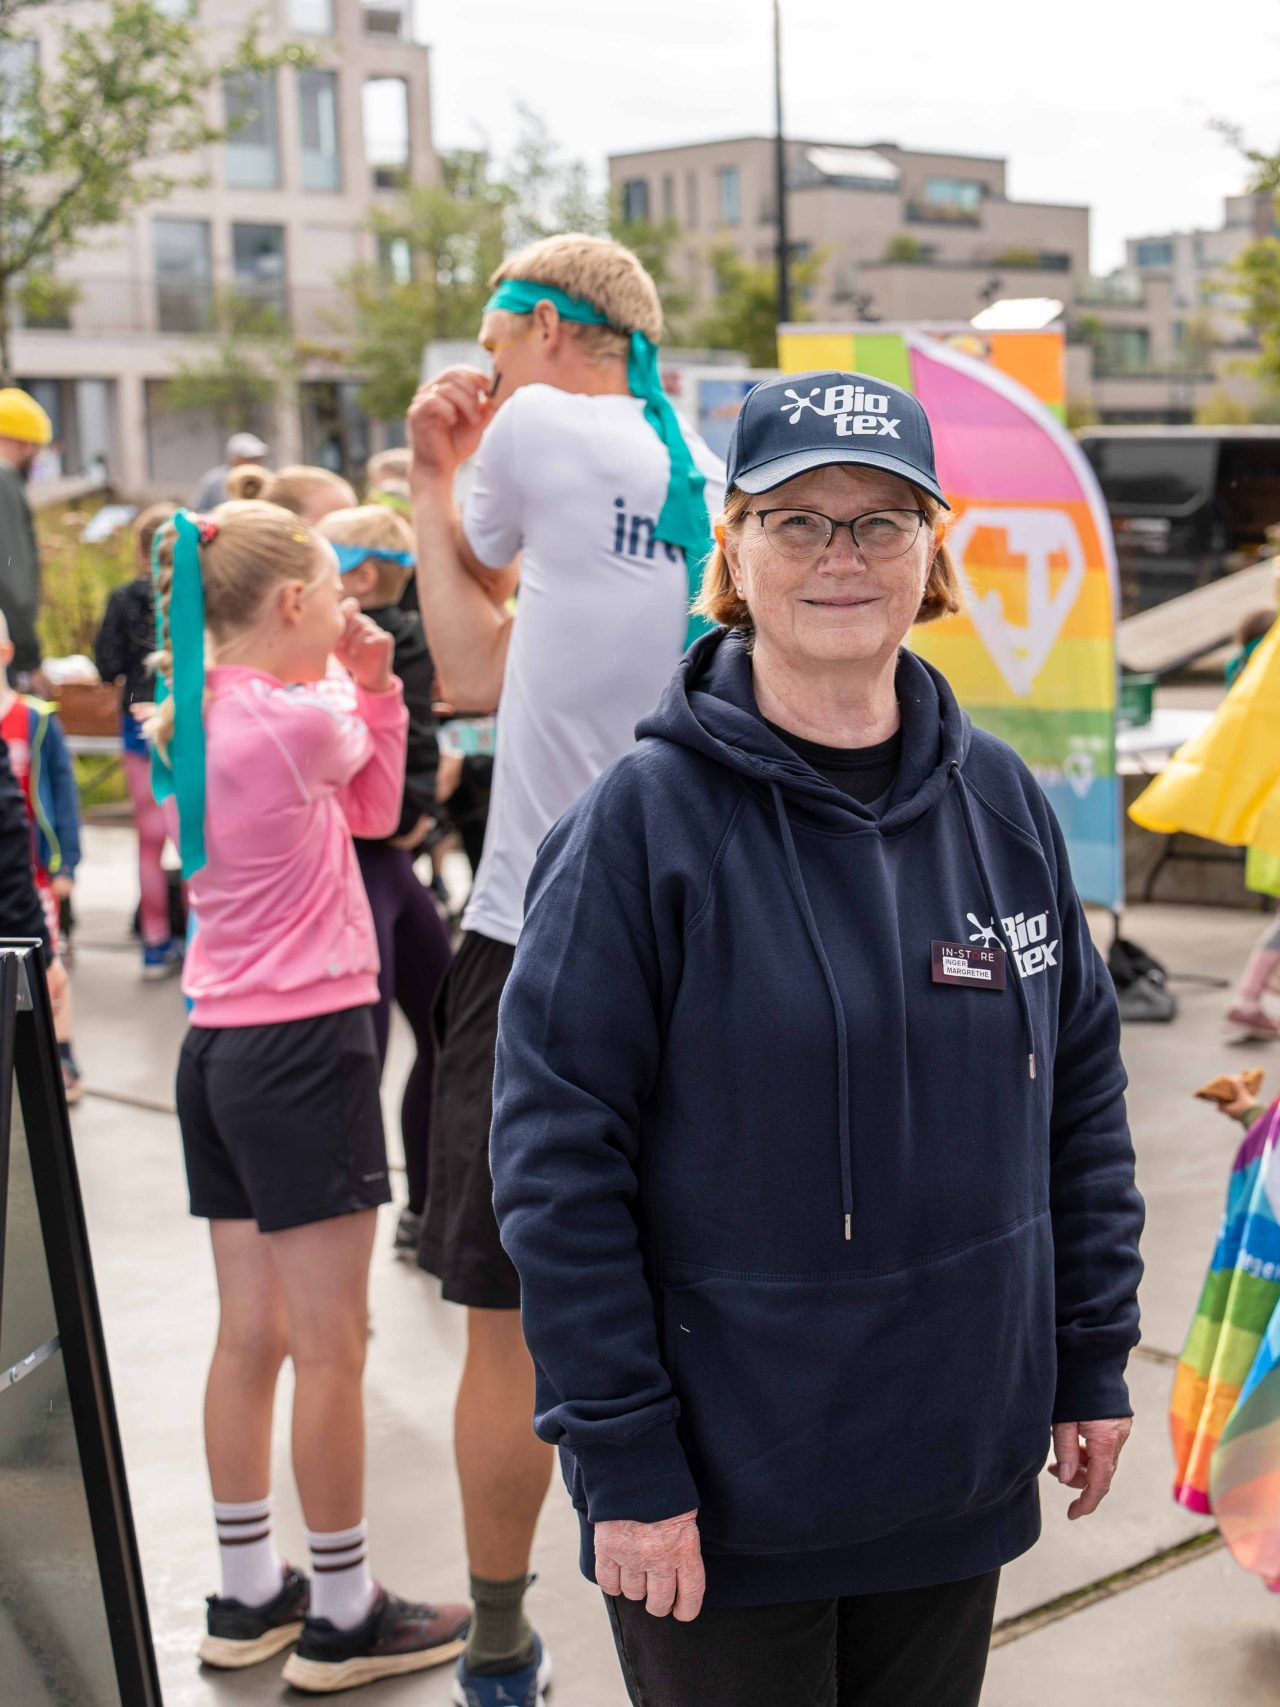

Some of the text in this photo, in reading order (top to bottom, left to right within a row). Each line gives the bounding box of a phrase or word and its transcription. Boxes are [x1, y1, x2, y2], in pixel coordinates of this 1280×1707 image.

[824, 385, 889, 415] Bio
[834, 412, 901, 439] tex
[945, 958, 967, 967] INGER
[946, 967, 990, 978] MARGRETHE
[1013, 940, 1058, 978] tex
